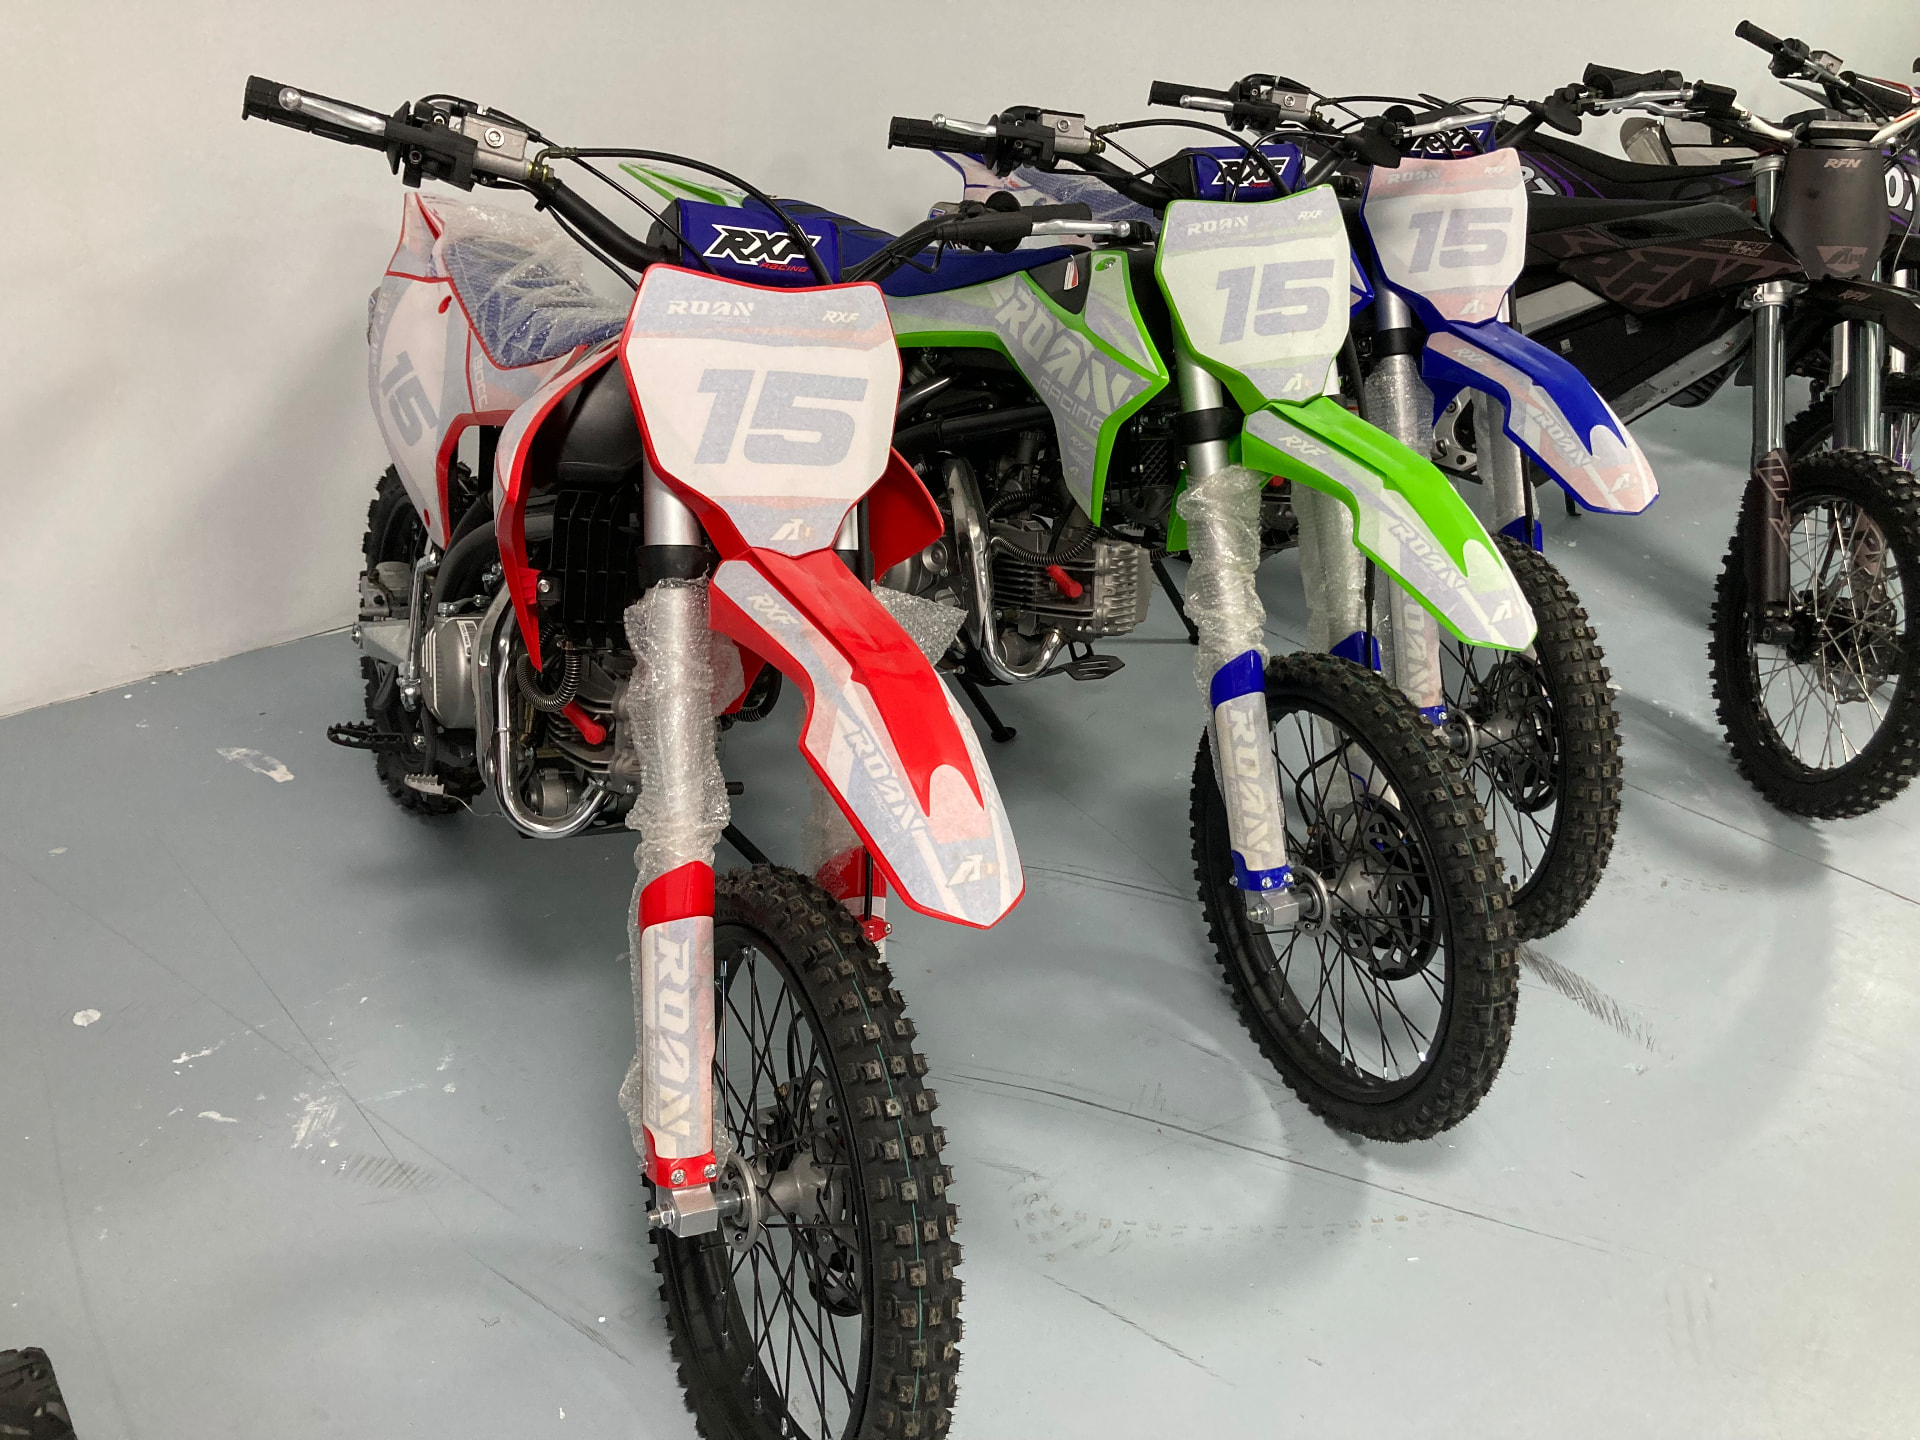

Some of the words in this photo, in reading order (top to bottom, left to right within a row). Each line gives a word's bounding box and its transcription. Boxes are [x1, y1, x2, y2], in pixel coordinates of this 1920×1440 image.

[1387, 169, 1440, 185] ROAN
[1483, 165, 1505, 177] RXF
[1824, 158, 1863, 169] RFN
[1187, 215, 1249, 236] ROAN
[1298, 209, 1323, 221] RXF
[1408, 207, 1513, 274] 15
[667, 300, 754, 317] ROAN
[822, 310, 860, 323] RXF
[1215, 259, 1335, 344] 15
[994, 297, 1132, 414] ROAN
[1452, 347, 1488, 363] RXF
[380, 350, 438, 447] 15
[694, 369, 869, 467] 15
[1278, 434, 1329, 457] RXF
[1535, 411, 1592, 467] ROAN
[1391, 522, 1467, 589] ROAN
[746, 592, 800, 626] RXF
[847, 729, 926, 831] ROAN
[1229, 707, 1273, 854] ROAN
[658, 936, 692, 1138] ROAN
